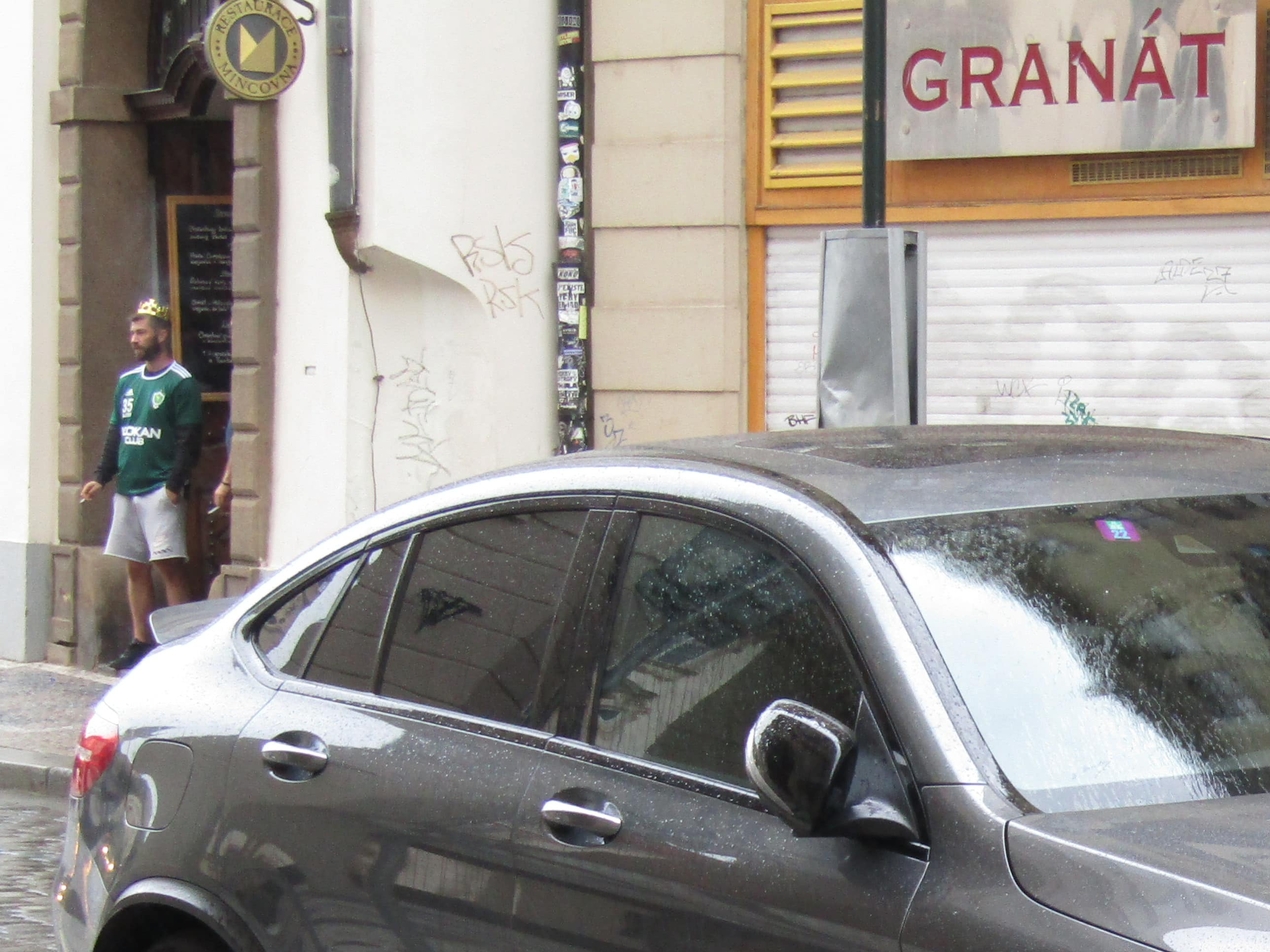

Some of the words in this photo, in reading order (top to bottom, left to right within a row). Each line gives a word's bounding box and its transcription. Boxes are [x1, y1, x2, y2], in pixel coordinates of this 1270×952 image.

[215, 0, 298, 37] RESTAURACE
[902, 8, 1226, 112] GRANÁT
[219, 62, 298, 94] MINCOVNA
[1110, 529, 1132, 540] 22
